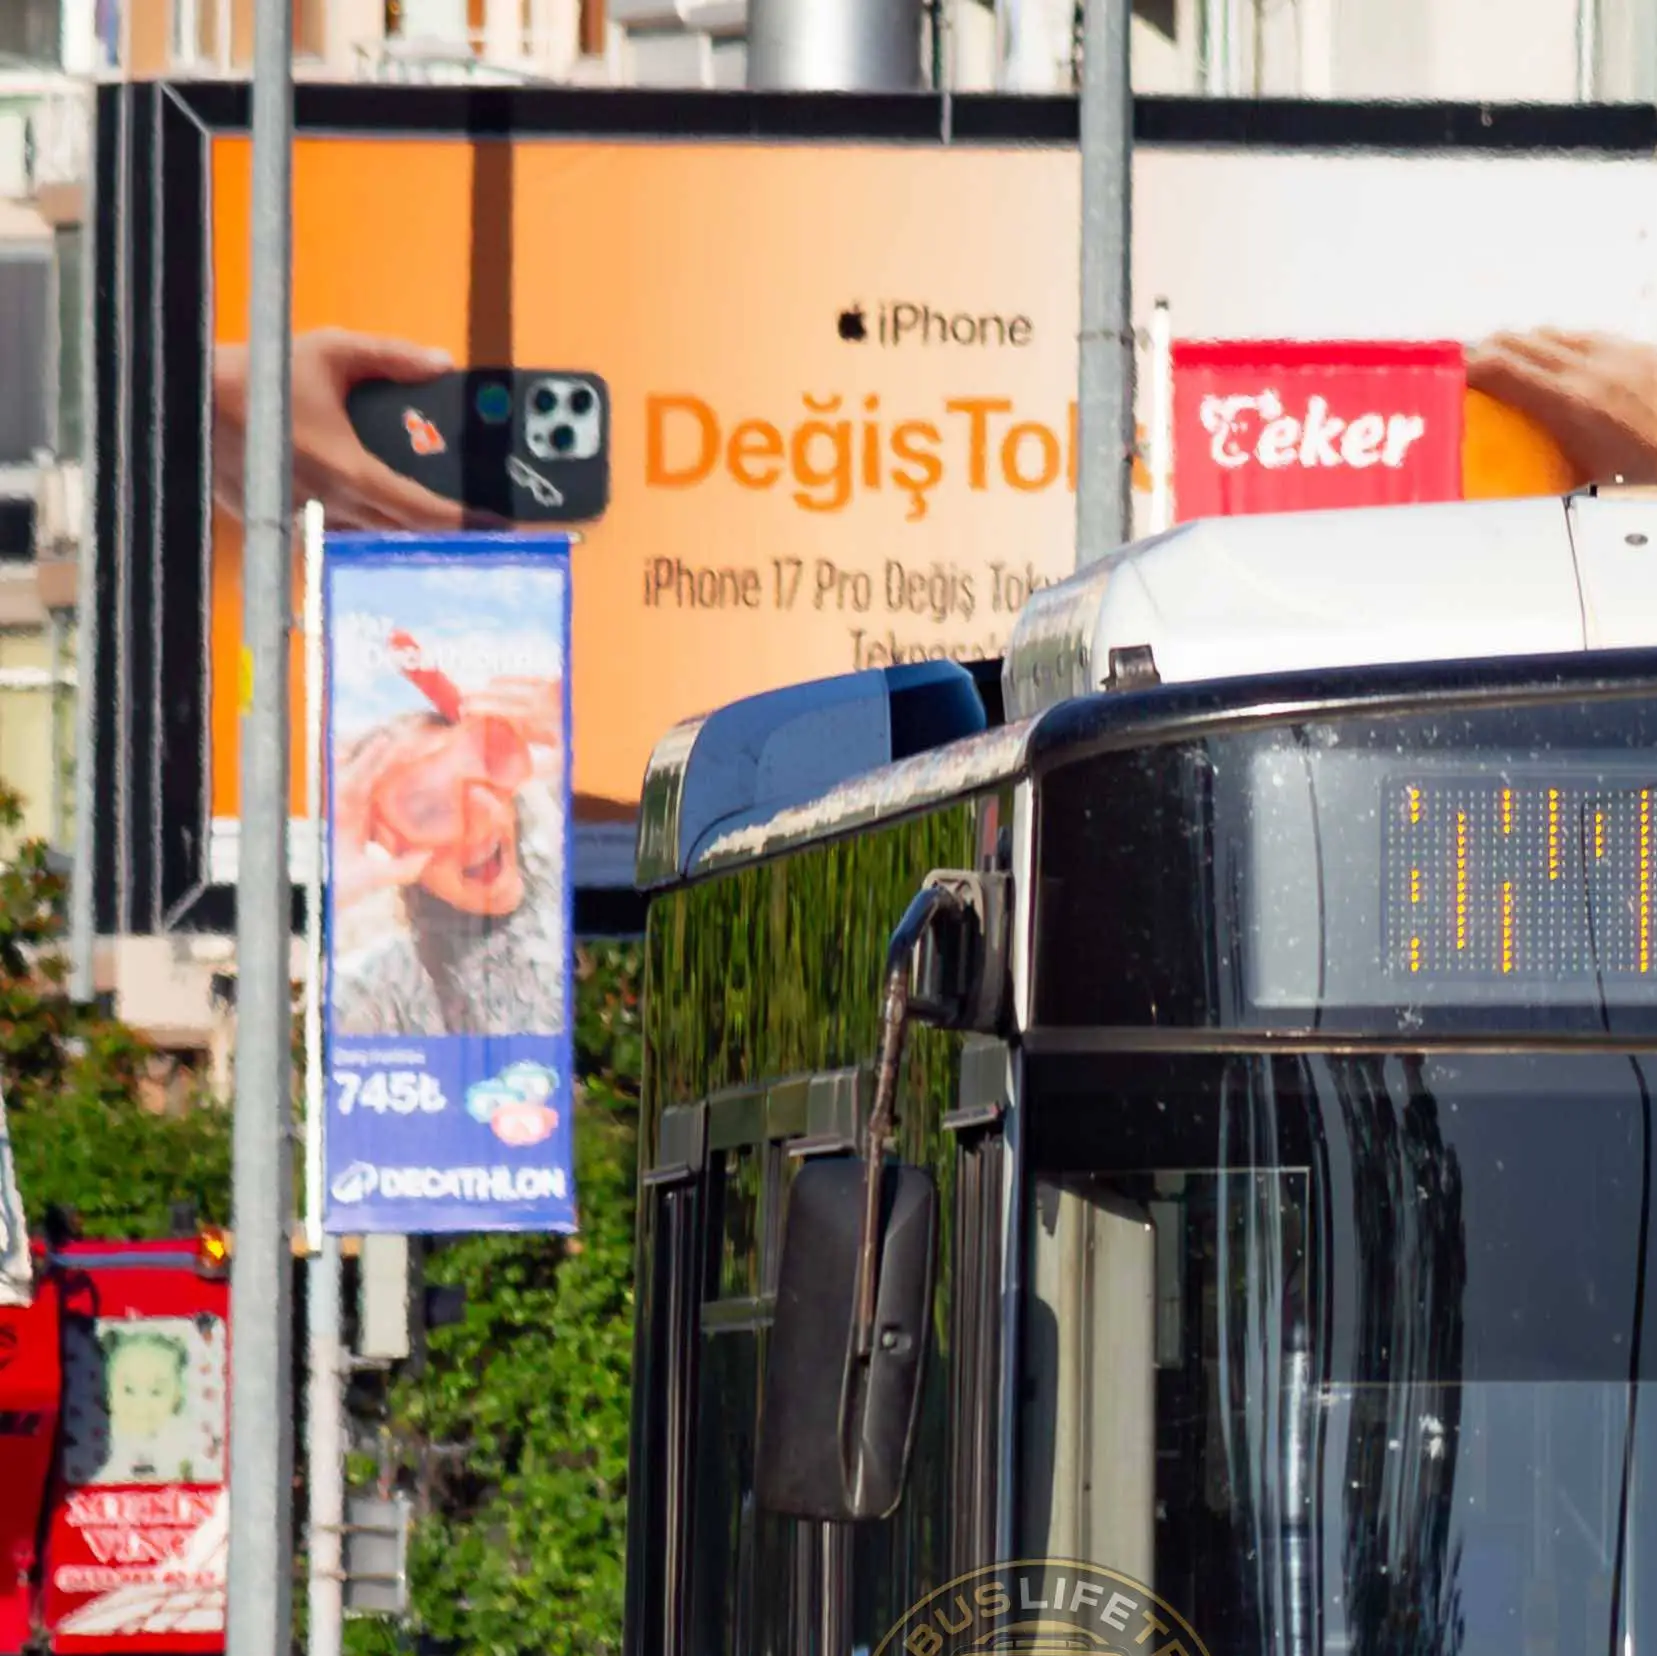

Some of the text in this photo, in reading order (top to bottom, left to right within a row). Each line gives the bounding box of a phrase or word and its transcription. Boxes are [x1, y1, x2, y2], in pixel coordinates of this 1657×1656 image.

[879, 303, 1032, 345] iPhone
[644, 558, 761, 609] iPhone
[773, 559, 803, 611] 17
[813, 562, 871, 613] Pro
[885, 561, 976, 622] Değiş
